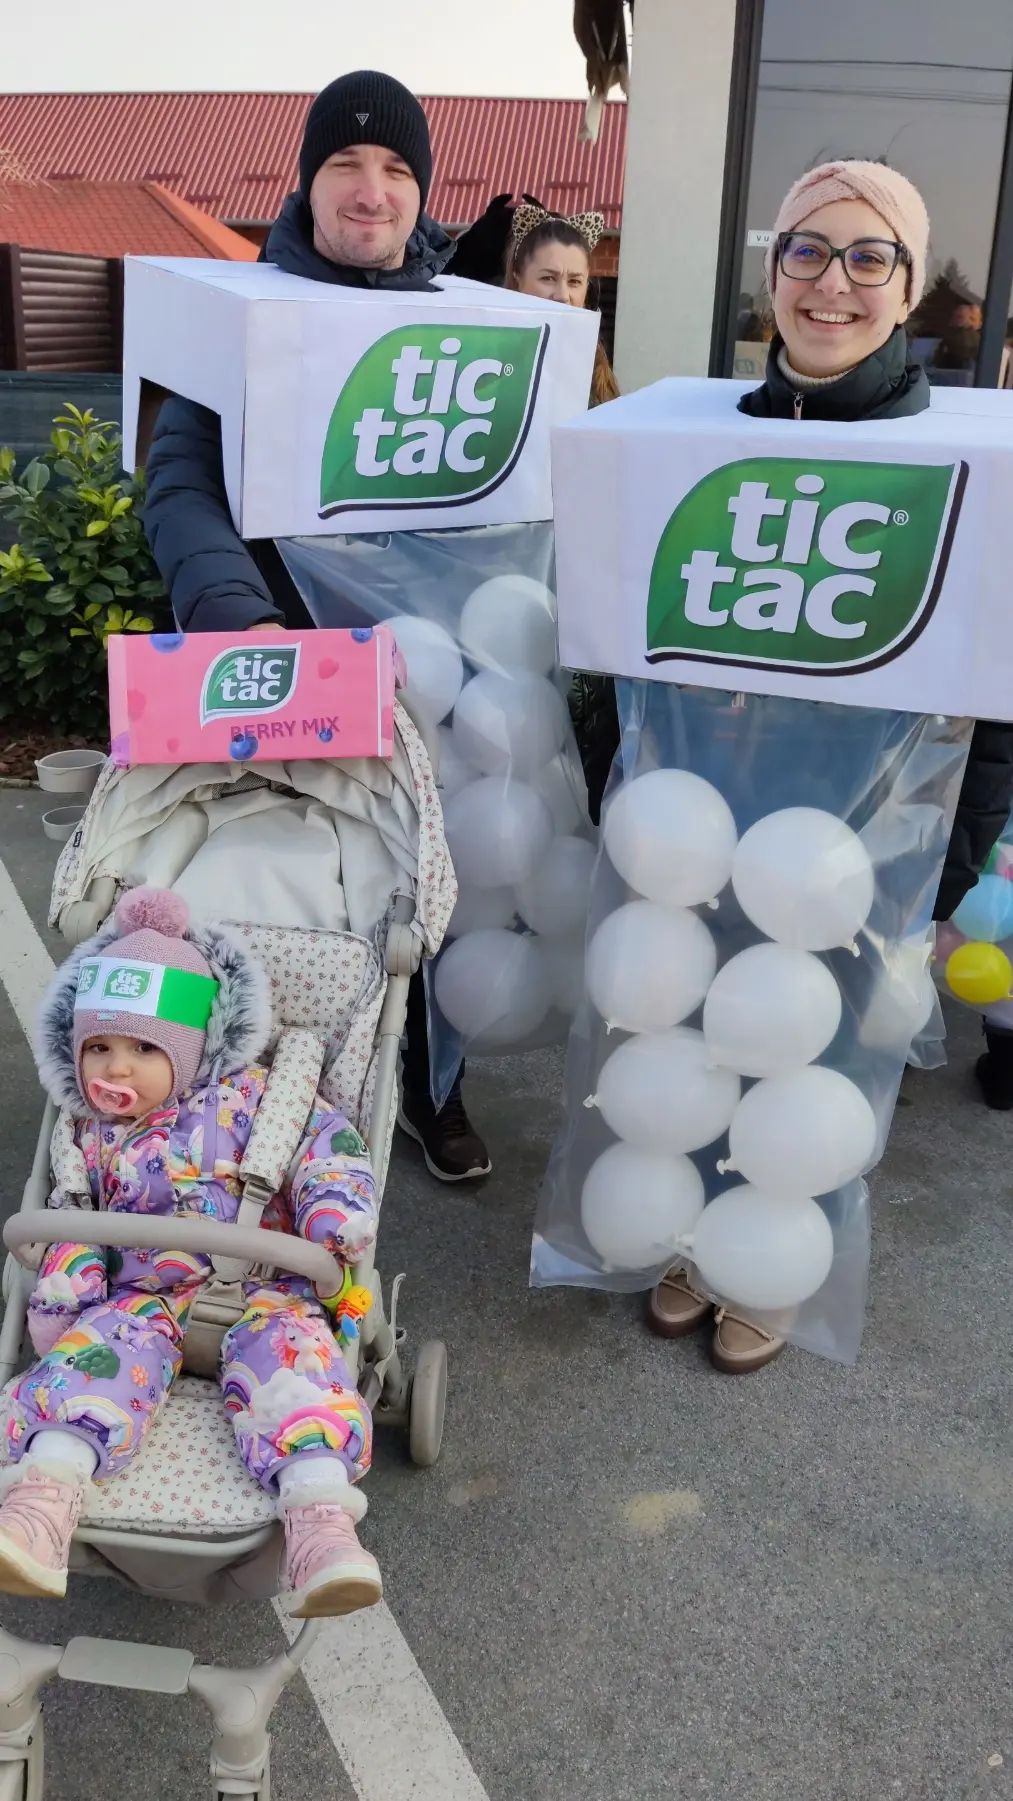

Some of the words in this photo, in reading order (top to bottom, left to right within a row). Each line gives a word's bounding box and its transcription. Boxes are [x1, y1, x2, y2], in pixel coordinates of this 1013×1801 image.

[353, 408, 493, 477] tac
[680, 550, 877, 639] tac
[221, 677, 281, 702] tac
[110, 978, 141, 996] tac
[117, 969, 142, 986] tic
